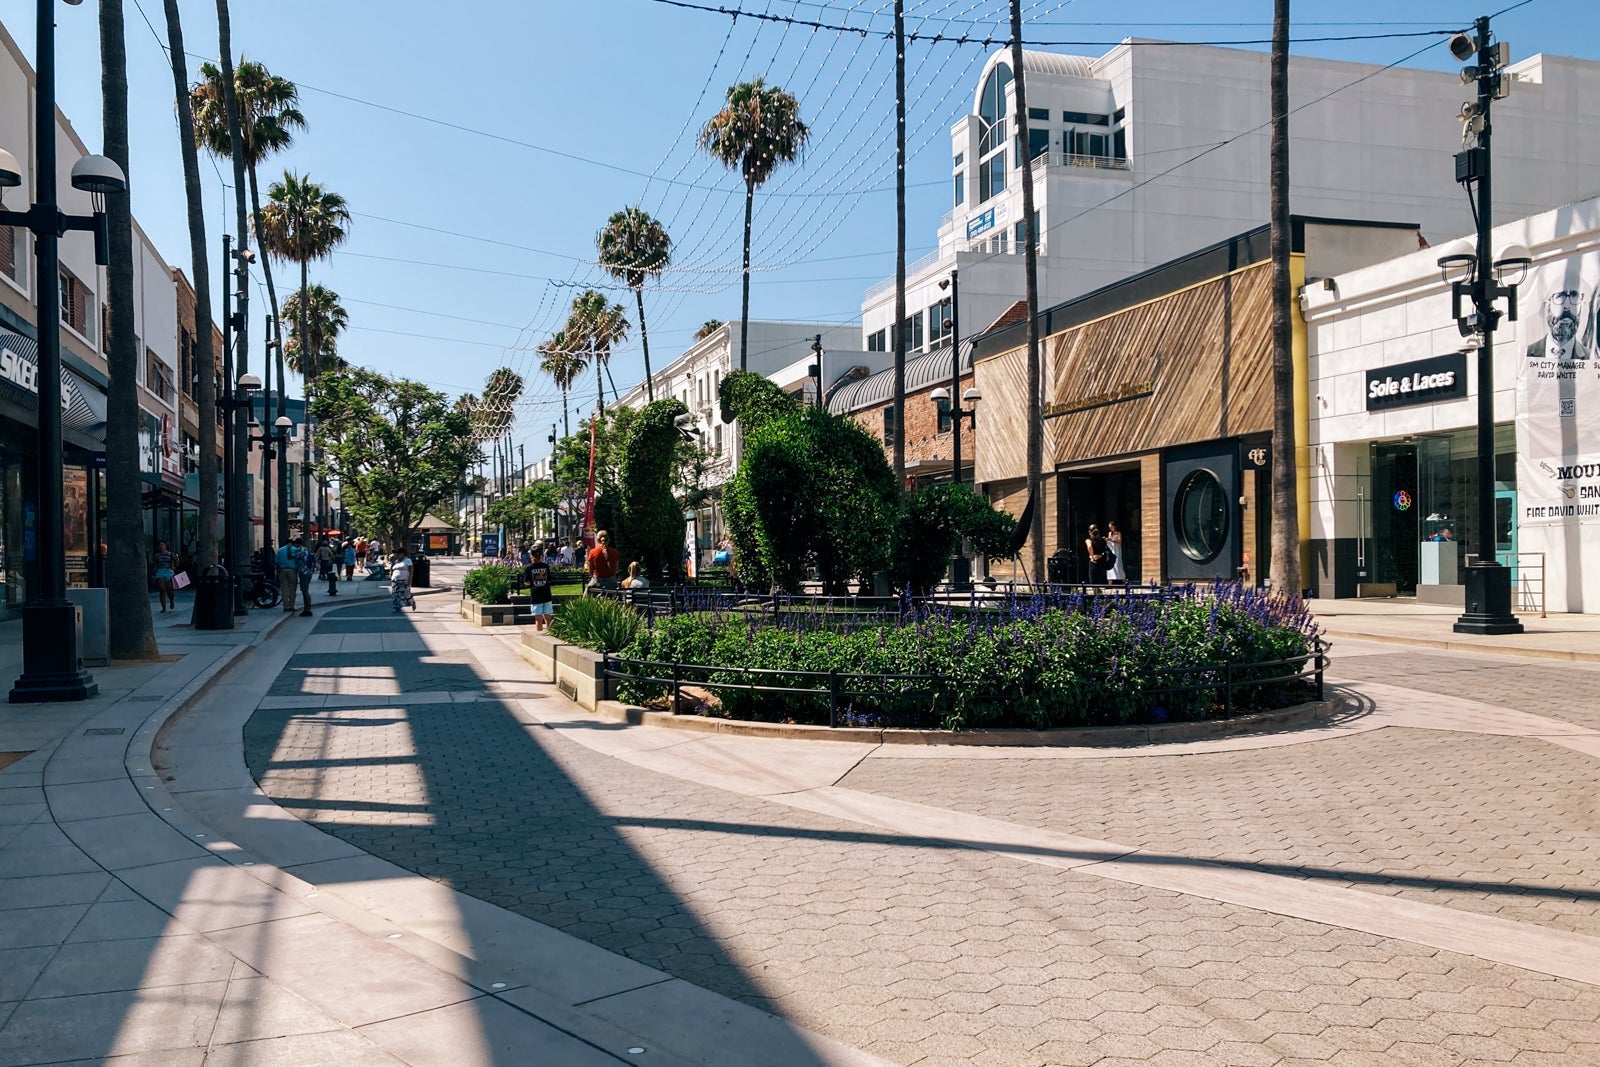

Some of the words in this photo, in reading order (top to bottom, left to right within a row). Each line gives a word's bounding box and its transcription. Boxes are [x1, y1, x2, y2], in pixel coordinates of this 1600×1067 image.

[1529, 361, 1539, 369] SM
[1540, 361, 1555, 370] CITY
[1557, 361, 1585, 370] MANAGER
[1537, 371, 1555, 379] DAVID
[1556, 371, 1576, 380] WHITE
[1368, 377, 1399, 398] Sole
[1400, 377, 1412, 393] &
[1412, 371, 1455, 391] Laces
[1557, 464, 1600, 480] MOU
[1526, 506, 1546, 518] FIRE
[1548, 505, 1574, 517] DAVID
